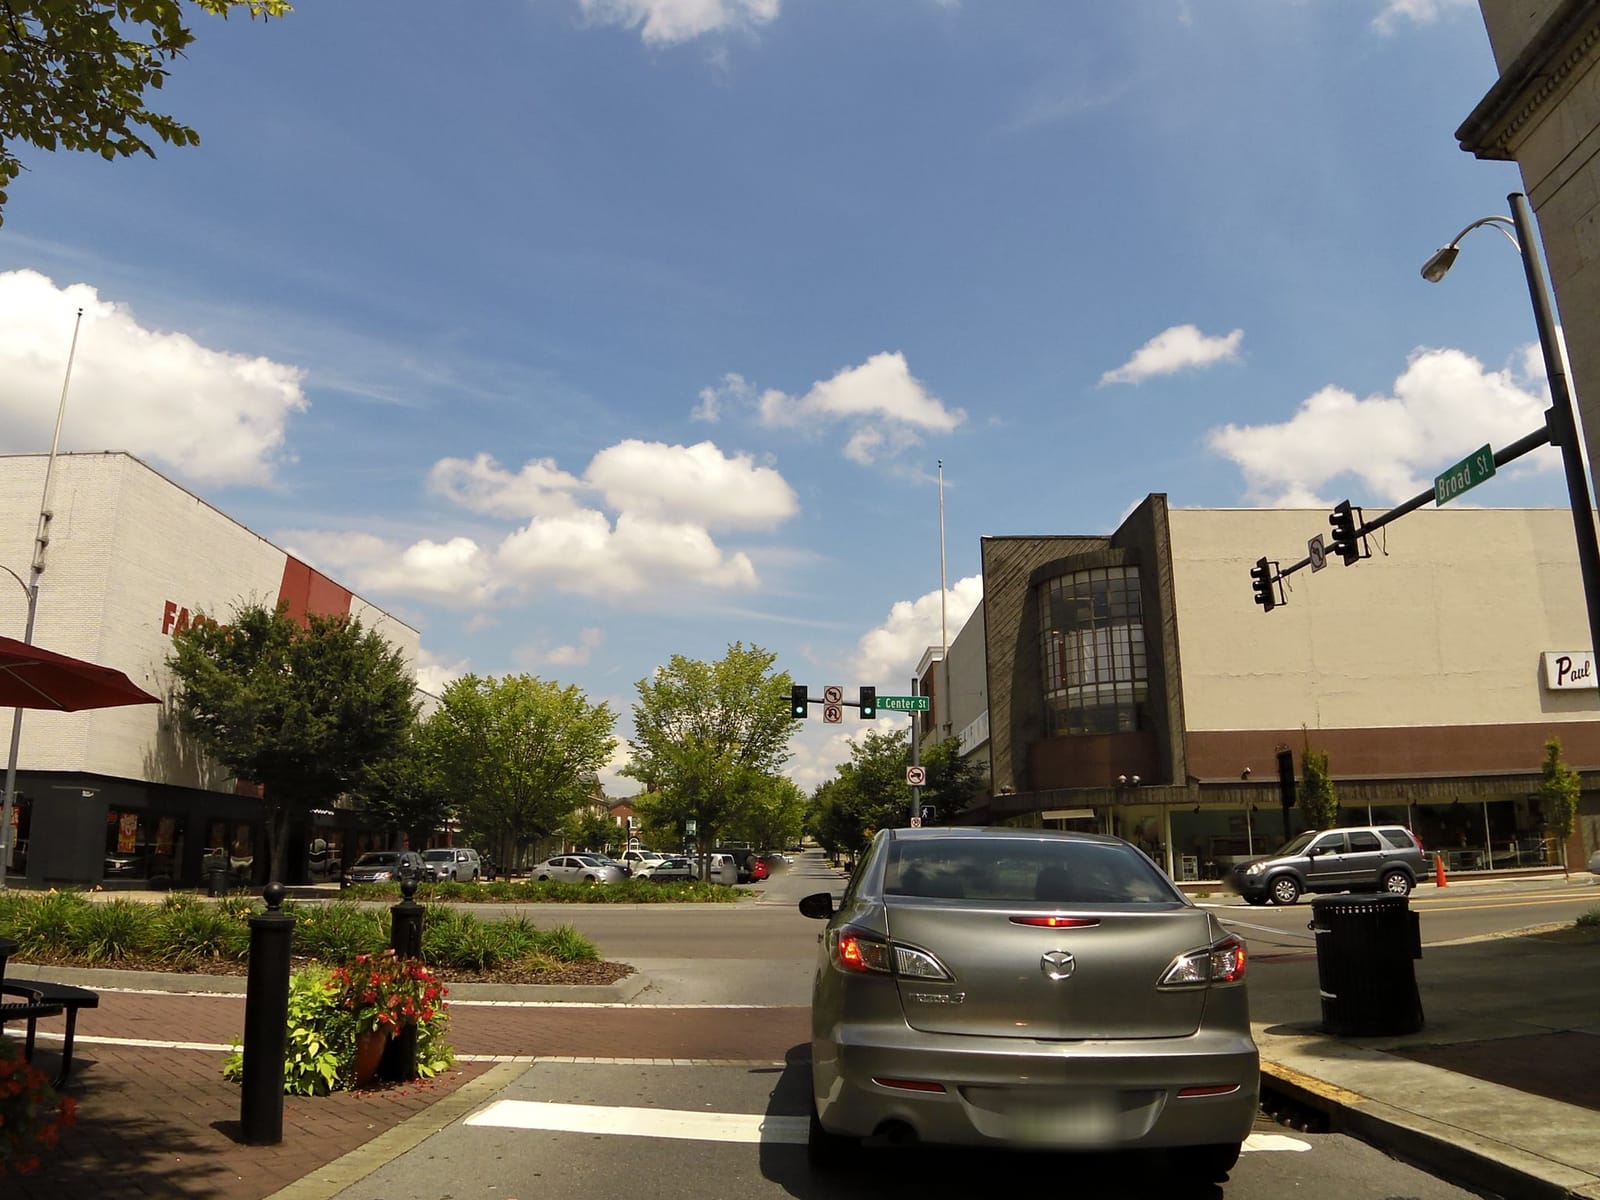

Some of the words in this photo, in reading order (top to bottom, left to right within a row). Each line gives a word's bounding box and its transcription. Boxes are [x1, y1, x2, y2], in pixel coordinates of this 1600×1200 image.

[1438, 463, 1471, 500] Broad
[1476, 454, 1489, 476] St
[1555, 656, 1591, 686] Paul
[885, 698, 915, 709] Center
[918, 699, 926, 709] St
